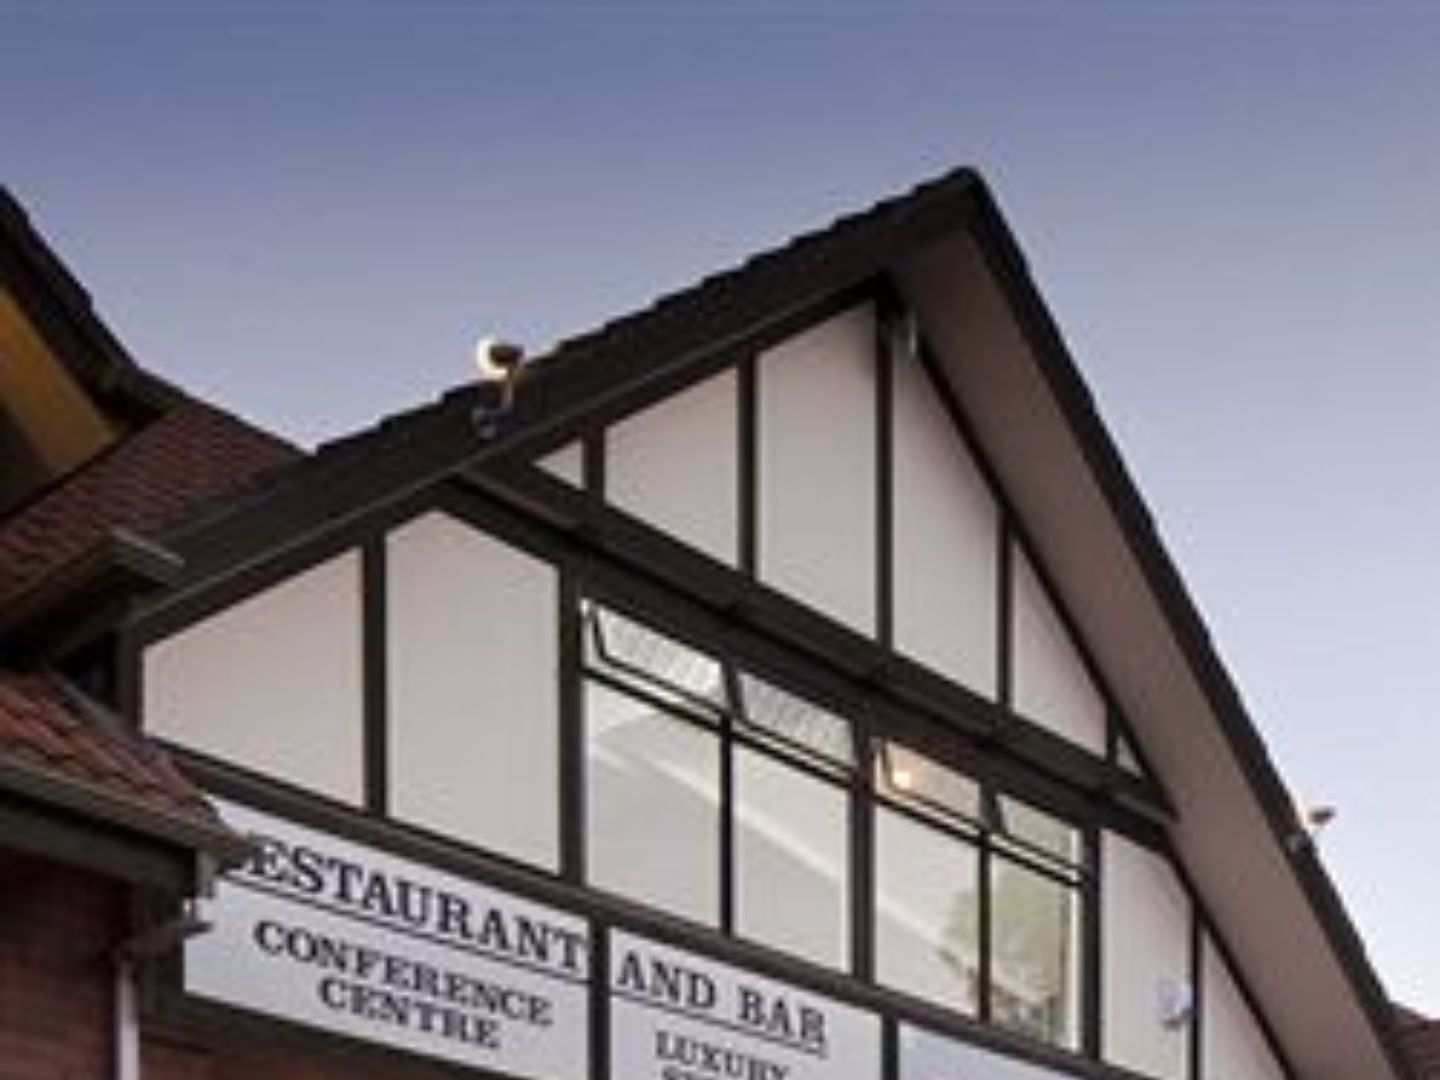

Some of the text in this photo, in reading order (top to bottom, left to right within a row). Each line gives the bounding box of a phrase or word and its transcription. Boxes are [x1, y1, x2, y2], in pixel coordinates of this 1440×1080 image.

[238, 834, 826, 1046] ESTAURANT AND BAR
[253, 920, 553, 1027] CONFERENCE
[318, 976, 500, 1049] CENTRE
